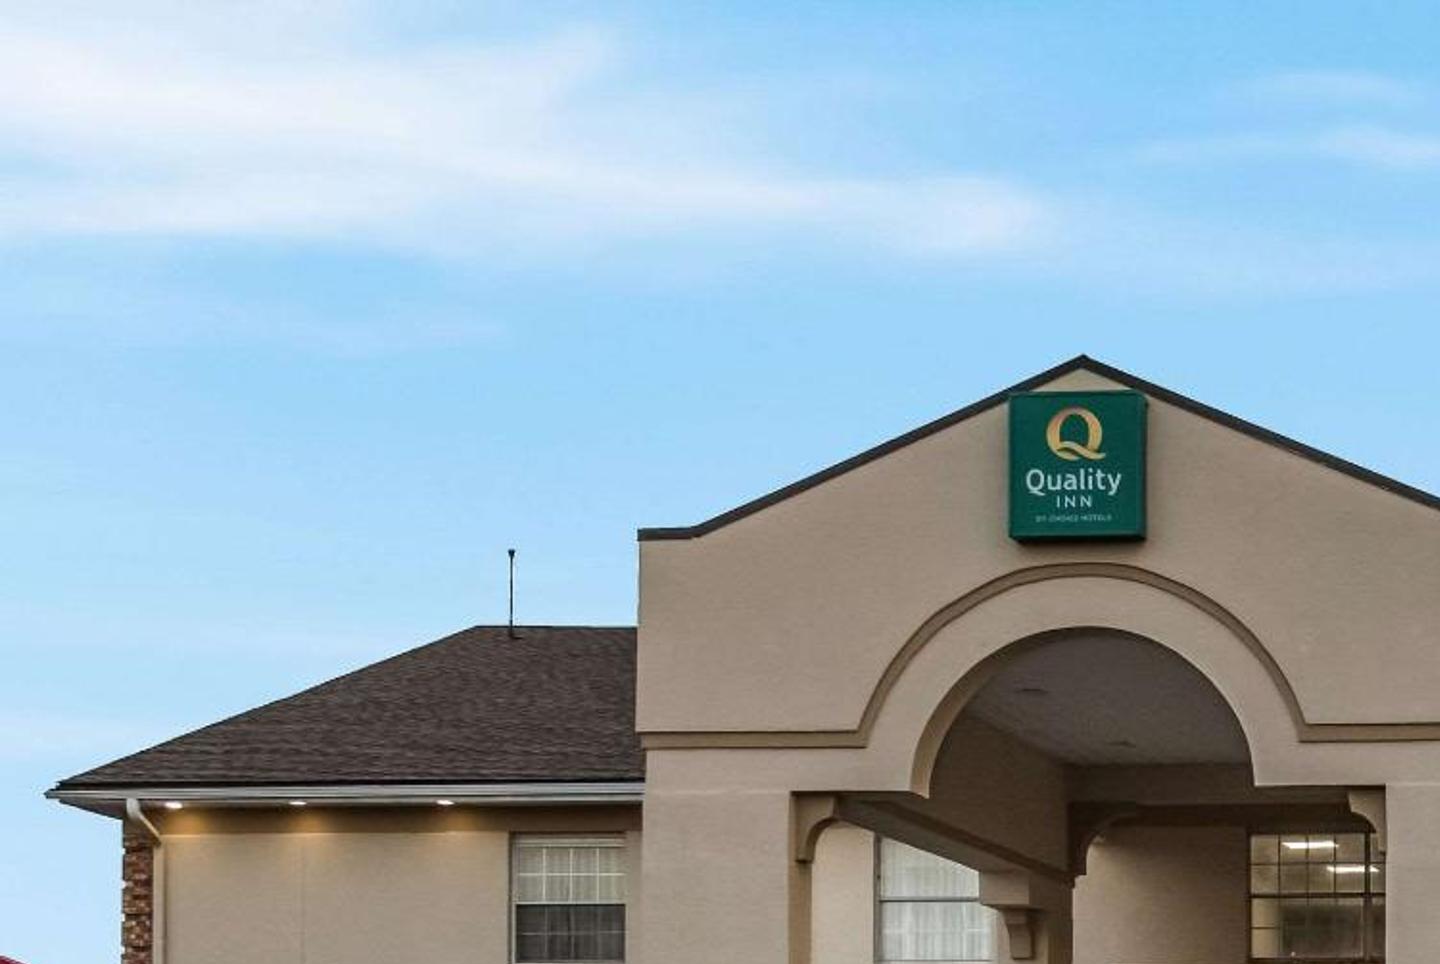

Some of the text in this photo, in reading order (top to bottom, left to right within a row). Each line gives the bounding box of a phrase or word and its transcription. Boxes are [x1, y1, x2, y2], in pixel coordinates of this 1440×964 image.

[1046, 406, 1106, 461] Q
[1026, 468, 1122, 496] Quality
[1056, 495, 1093, 508] INN
